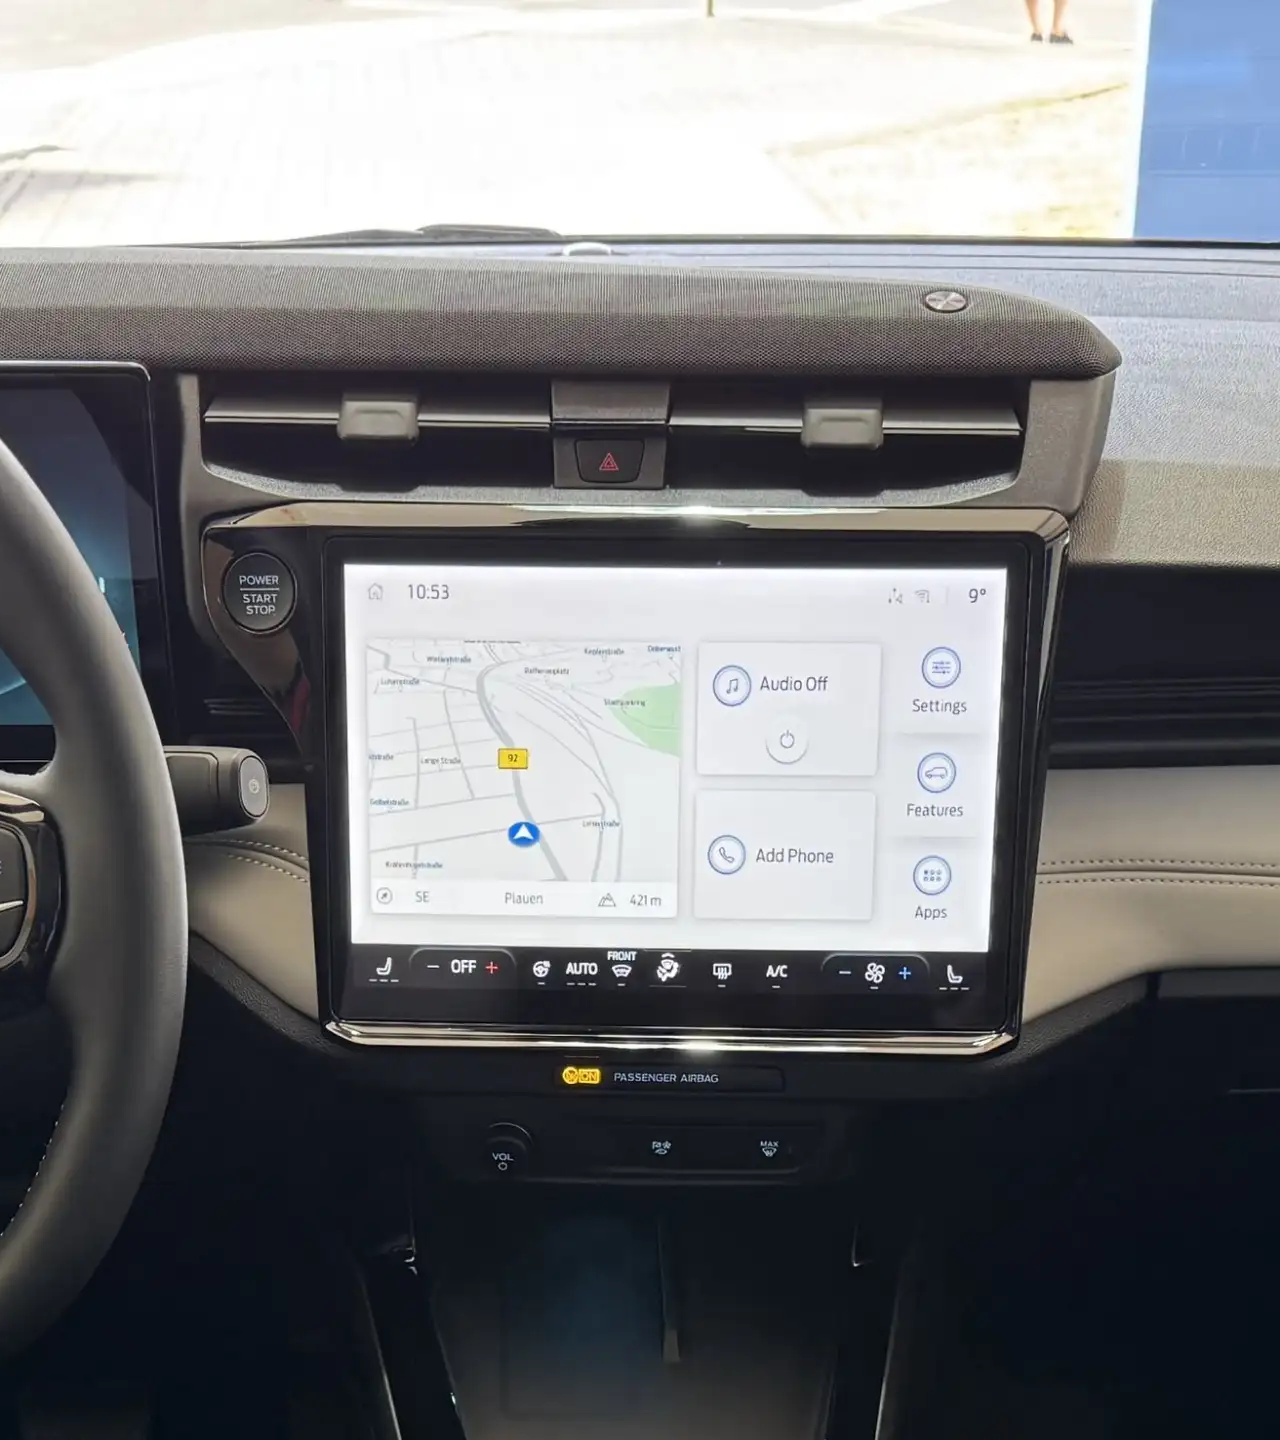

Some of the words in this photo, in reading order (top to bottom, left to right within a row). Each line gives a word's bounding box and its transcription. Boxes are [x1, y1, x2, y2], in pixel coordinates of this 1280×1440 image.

[238, 574, 280, 586] POWER
[242, 593, 278, 604] START
[407, 583, 451, 600] 10:53
[968, 587, 987, 604] 9°
[246, 605, 276, 615] STOP
[760, 675, 803, 692] Audio
[805, 675, 829, 692] Off
[912, 698, 968, 716] Settings
[507, 752, 519, 764] 92
[906, 802, 964, 818] Features
[755, 848, 785, 864] Add
[787, 848, 835, 864] Phone
[415, 890, 430, 904] SE
[504, 891, 544, 905] Plauen
[629, 894, 653, 907] 421
[653, 896, 662, 907] m
[914, 905, 948, 921] Apps
[607, 950, 637, 962] FRONT
[451, 958, 477, 974] OFF
[566, 962, 599, 976] AUTO
[766, 964, 788, 979] A/C
[580, 1071, 598, 1082] ON
[613, 1072, 677, 1083] PASSENGER
[680, 1073, 719, 1084] AIRBAG
[492, 1152, 514, 1161] VOL
